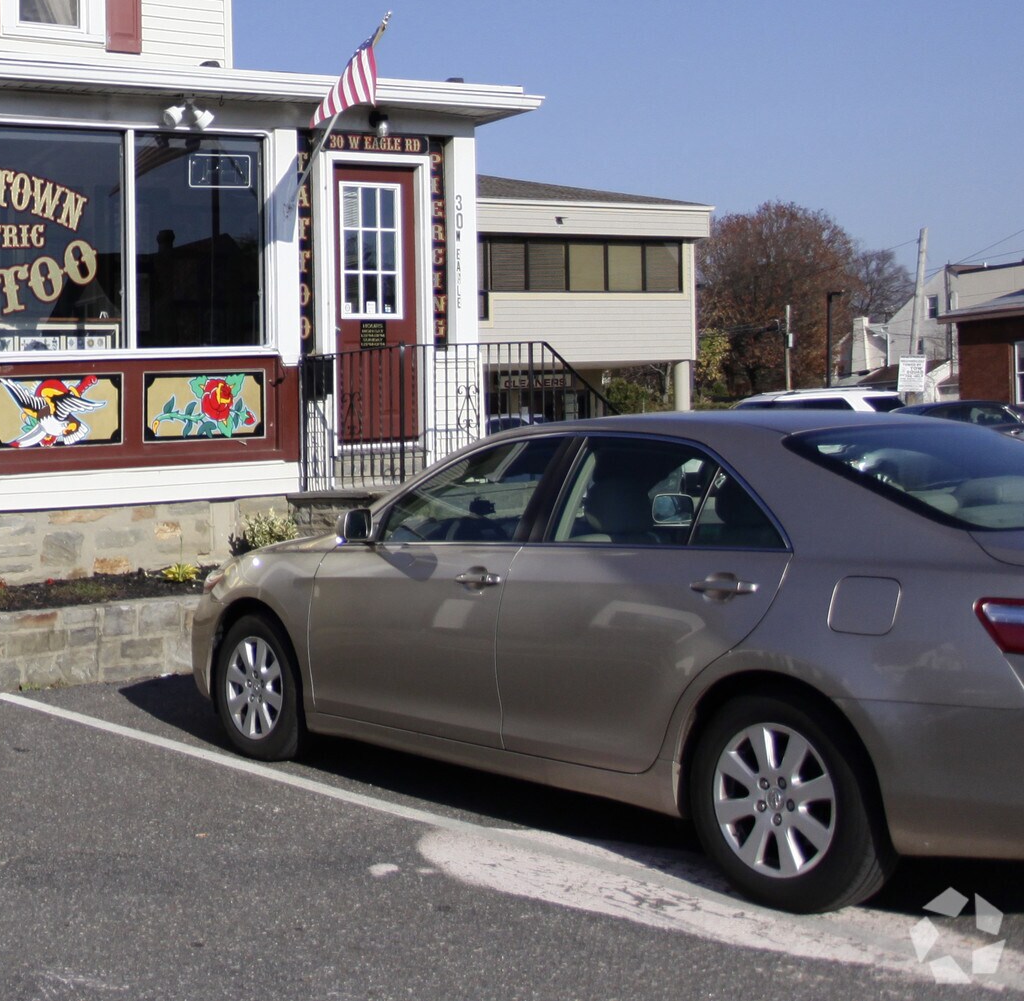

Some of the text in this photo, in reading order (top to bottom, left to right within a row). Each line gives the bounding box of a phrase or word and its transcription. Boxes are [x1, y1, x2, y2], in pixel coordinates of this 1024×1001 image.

[329, 134, 422, 152] 30 W EAGLE RD
[297, 152, 312, 339] TATTOO
[430, 153, 447, 337] PIERCING
[455, 194, 464, 230] 30
